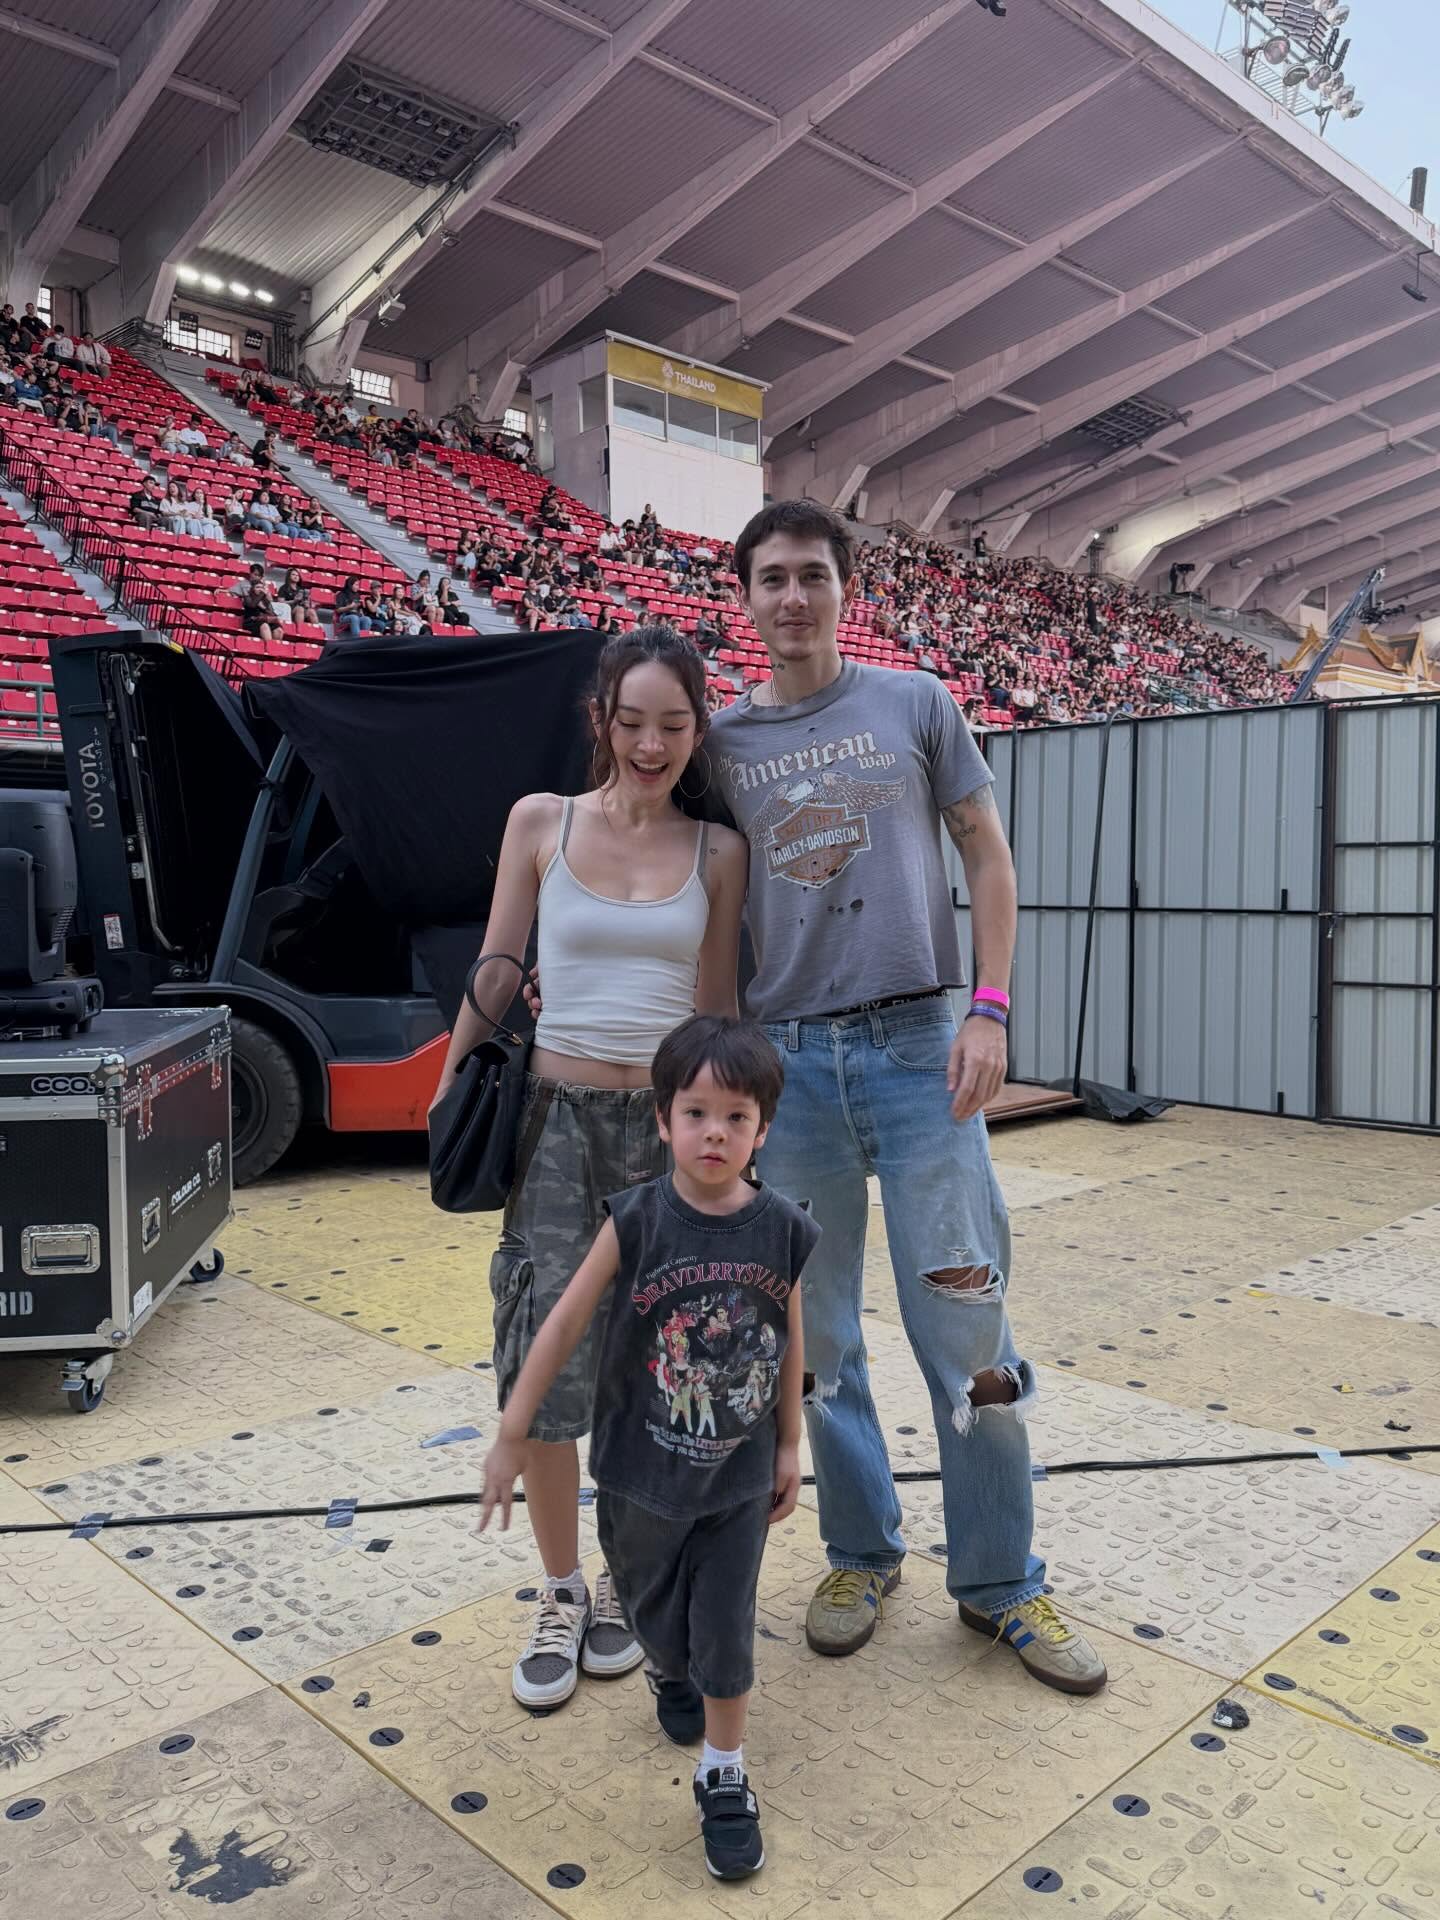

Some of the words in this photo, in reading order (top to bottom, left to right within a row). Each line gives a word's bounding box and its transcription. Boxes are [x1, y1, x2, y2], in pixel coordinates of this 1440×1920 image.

[675, 371, 716, 392] THAILAND
[78, 743, 105, 829] TOYOTA
[730, 731, 877, 799] American
[856, 752, 897, 770] way
[770, 825, 860, 867] HARLEY-DAVIDSON
[31, 1076, 96, 1095] CCO.
